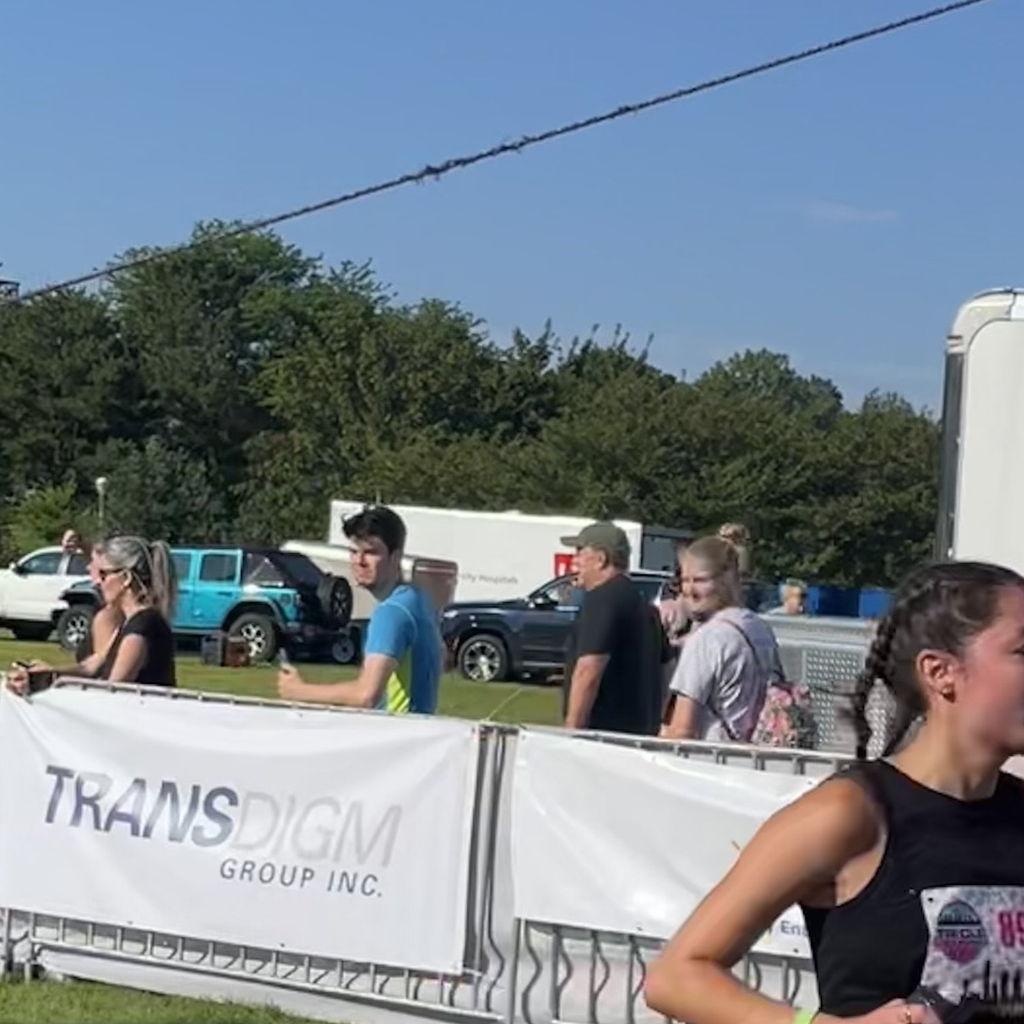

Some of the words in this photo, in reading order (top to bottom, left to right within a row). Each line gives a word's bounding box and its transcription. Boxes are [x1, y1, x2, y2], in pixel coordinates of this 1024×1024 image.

[45, 765, 403, 867] TRANSDIGM
[220, 858, 315, 888] GROUP
[327, 871, 382, 897] INC.
